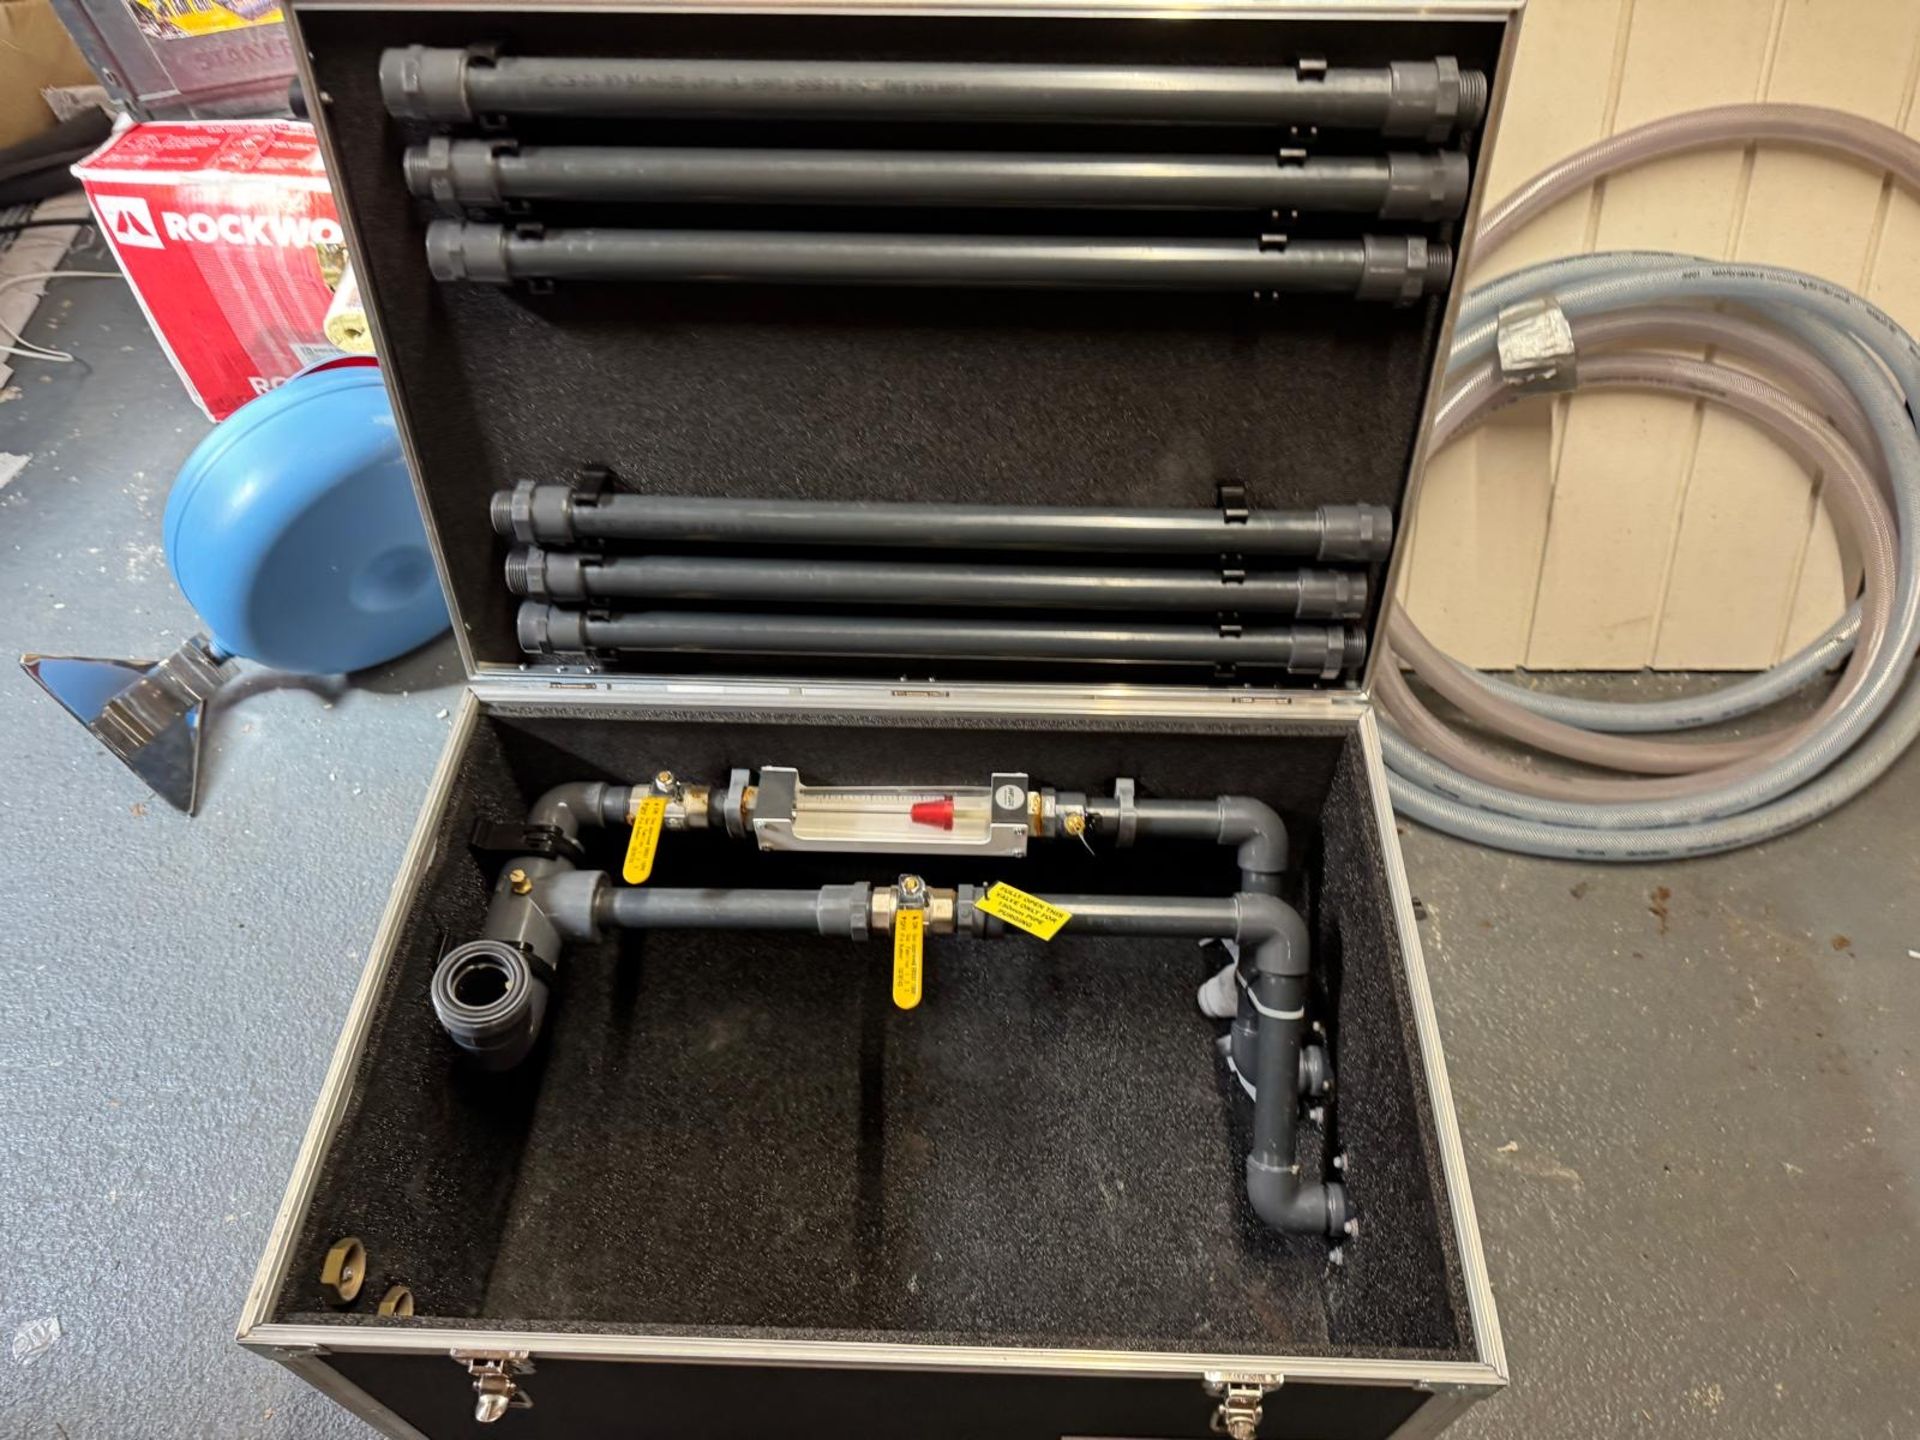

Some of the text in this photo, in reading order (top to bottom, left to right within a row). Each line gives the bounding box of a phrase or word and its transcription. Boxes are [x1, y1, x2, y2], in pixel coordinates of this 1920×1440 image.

[1024, 897, 1044, 910] OPEN
[1019, 902, 1040, 915] ONLY
[1040, 912, 1058, 924] FOR
